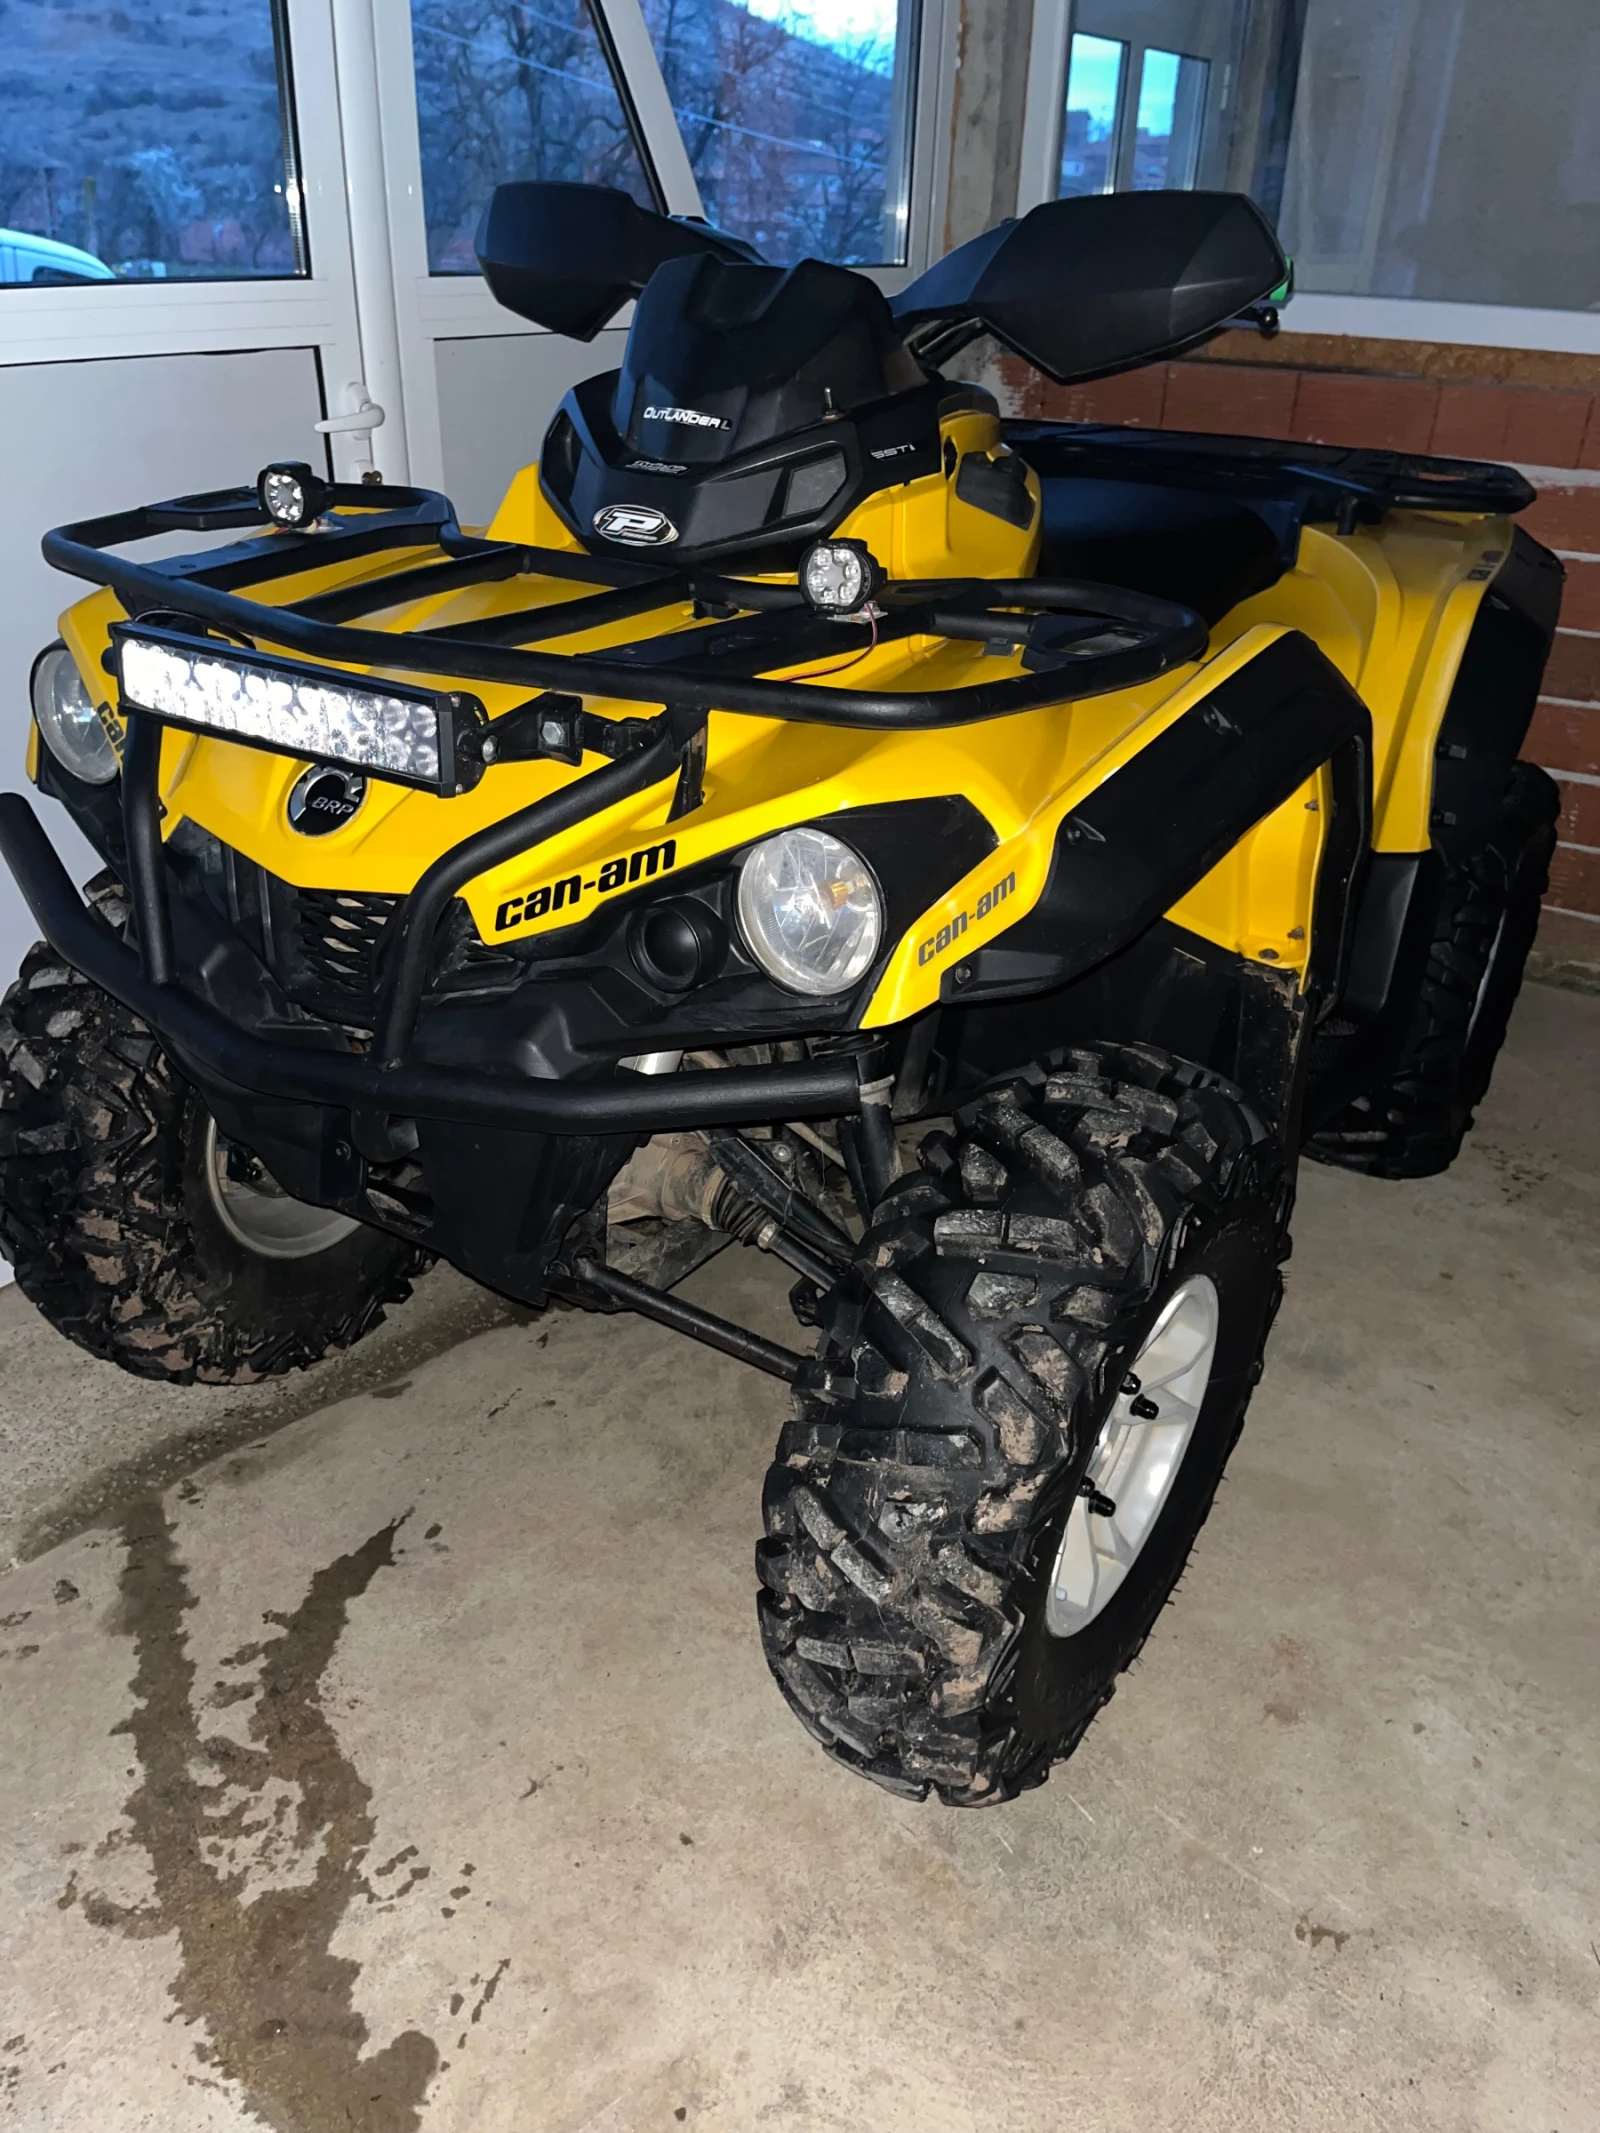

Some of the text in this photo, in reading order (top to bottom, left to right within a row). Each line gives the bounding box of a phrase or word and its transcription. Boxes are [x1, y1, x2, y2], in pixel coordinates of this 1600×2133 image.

[311, 796, 355, 815] BRP
[495, 839, 677, 932] can-am
[918, 871, 1016, 967] can-am
